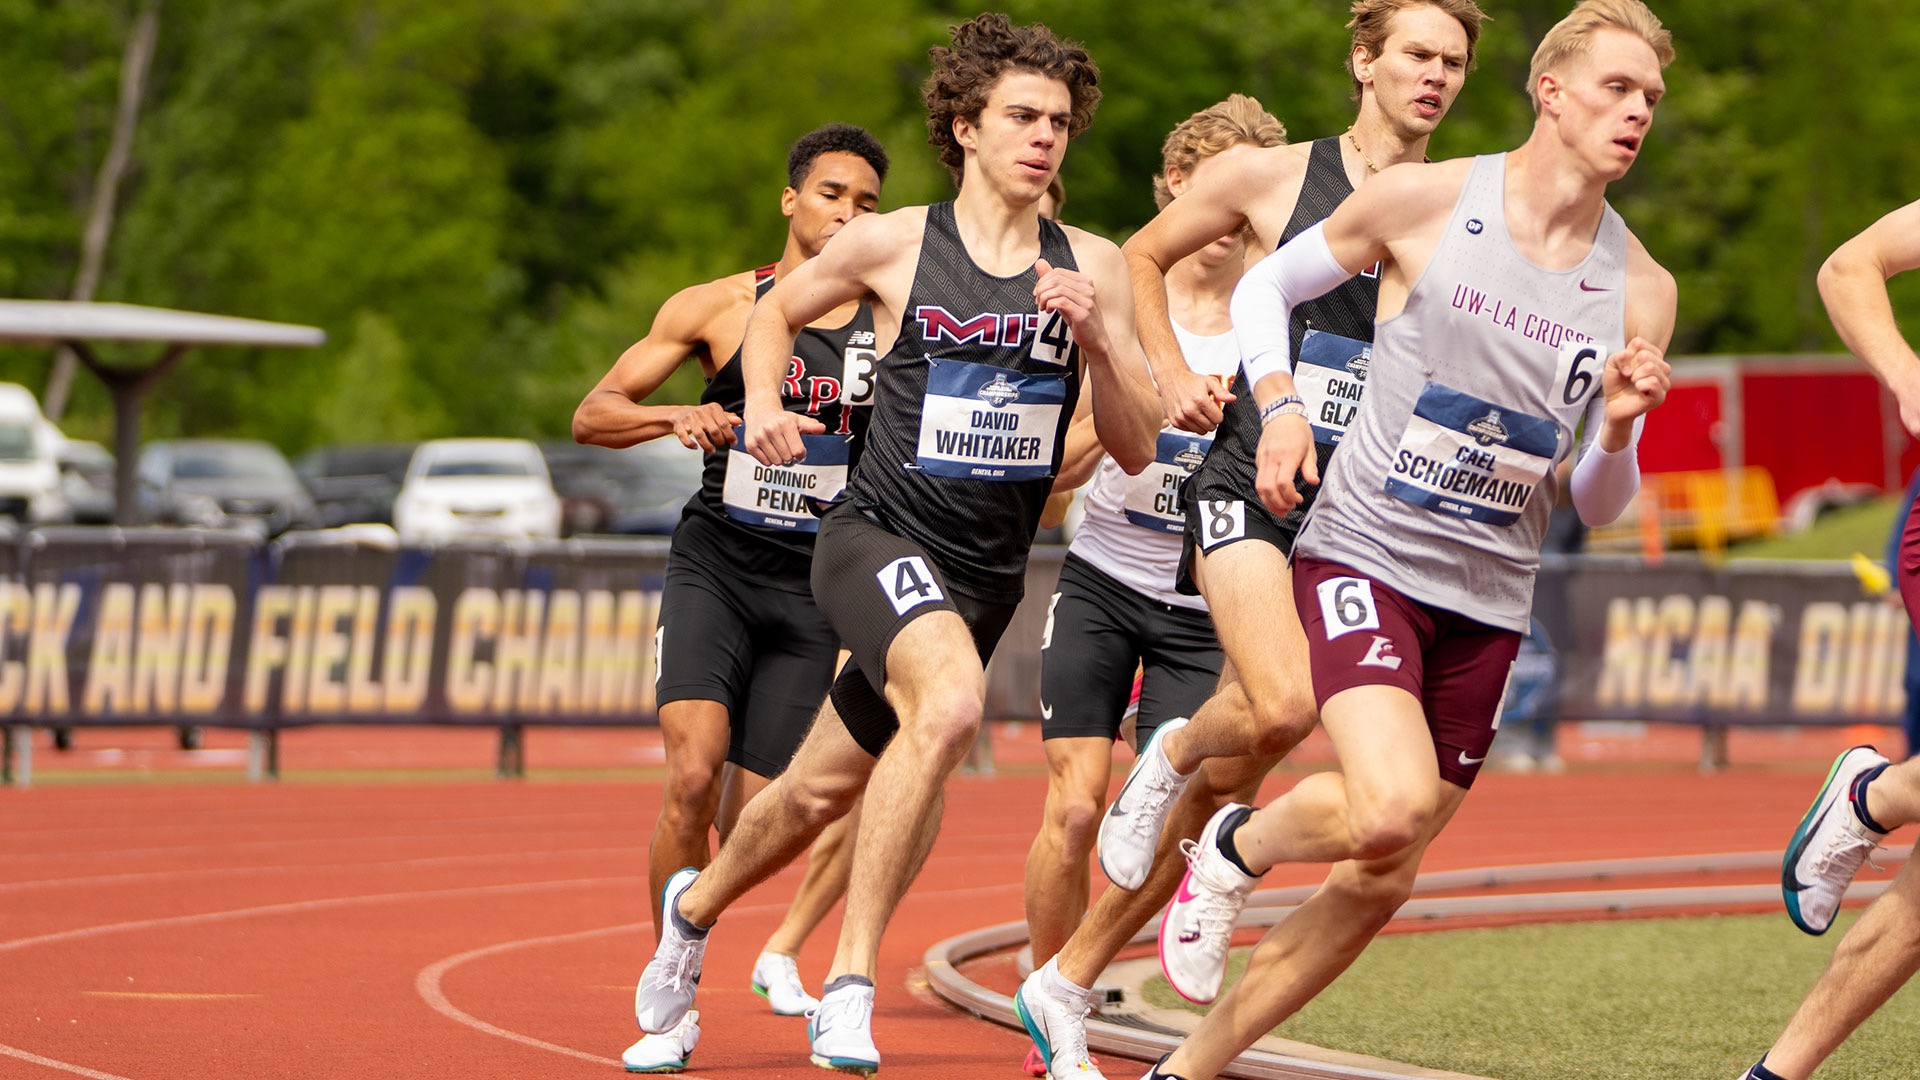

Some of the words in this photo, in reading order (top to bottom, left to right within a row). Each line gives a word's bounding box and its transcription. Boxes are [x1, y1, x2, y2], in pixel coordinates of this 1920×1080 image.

[916, 305, 1039, 347] MI
[1452, 283, 1516, 331] UW-LA
[1039, 308, 1069, 361] 4
[850, 352, 877, 403] 3
[1563, 348, 1598, 406] 6
[971, 410, 1019, 431] DAVID
[936, 429, 1041, 460] WHITAKER
[1455, 446, 1497, 472] CAEL
[754, 465, 817, 489] DOMINIC
[1394, 449, 1532, 508] SCHOEMANN
[756, 487, 808, 513] PENA
[1154, 492, 1185, 517] CL
[1208, 500, 1235, 540] 8
[895, 560, 932, 601] 4
[1334, 579, 1368, 627] 6
[82, 583, 237, 714] AND
[243, 585, 438, 714] FIELD
[1598, 595, 1772, 708] NCAA
